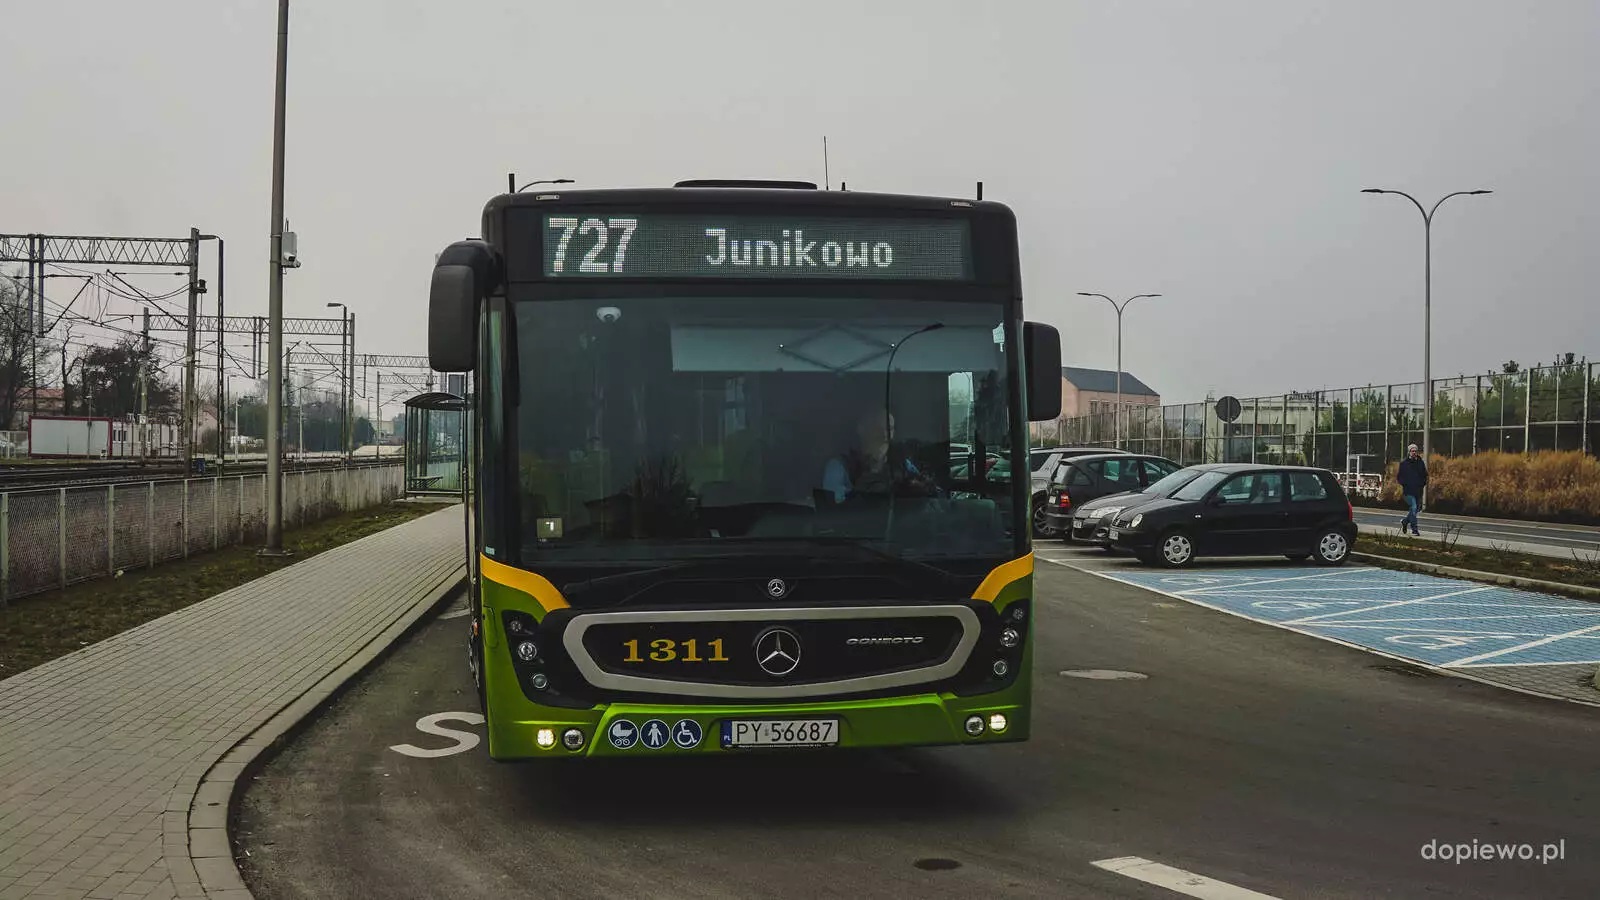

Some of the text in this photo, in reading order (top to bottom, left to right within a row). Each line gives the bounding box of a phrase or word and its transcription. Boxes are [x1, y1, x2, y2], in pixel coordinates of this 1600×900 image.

[548, 217, 893, 273] 727 Junikowo
[623, 638, 729, 662] 1311
[389, 712, 486, 758] S
[736, 722, 833, 742] PY 56687
